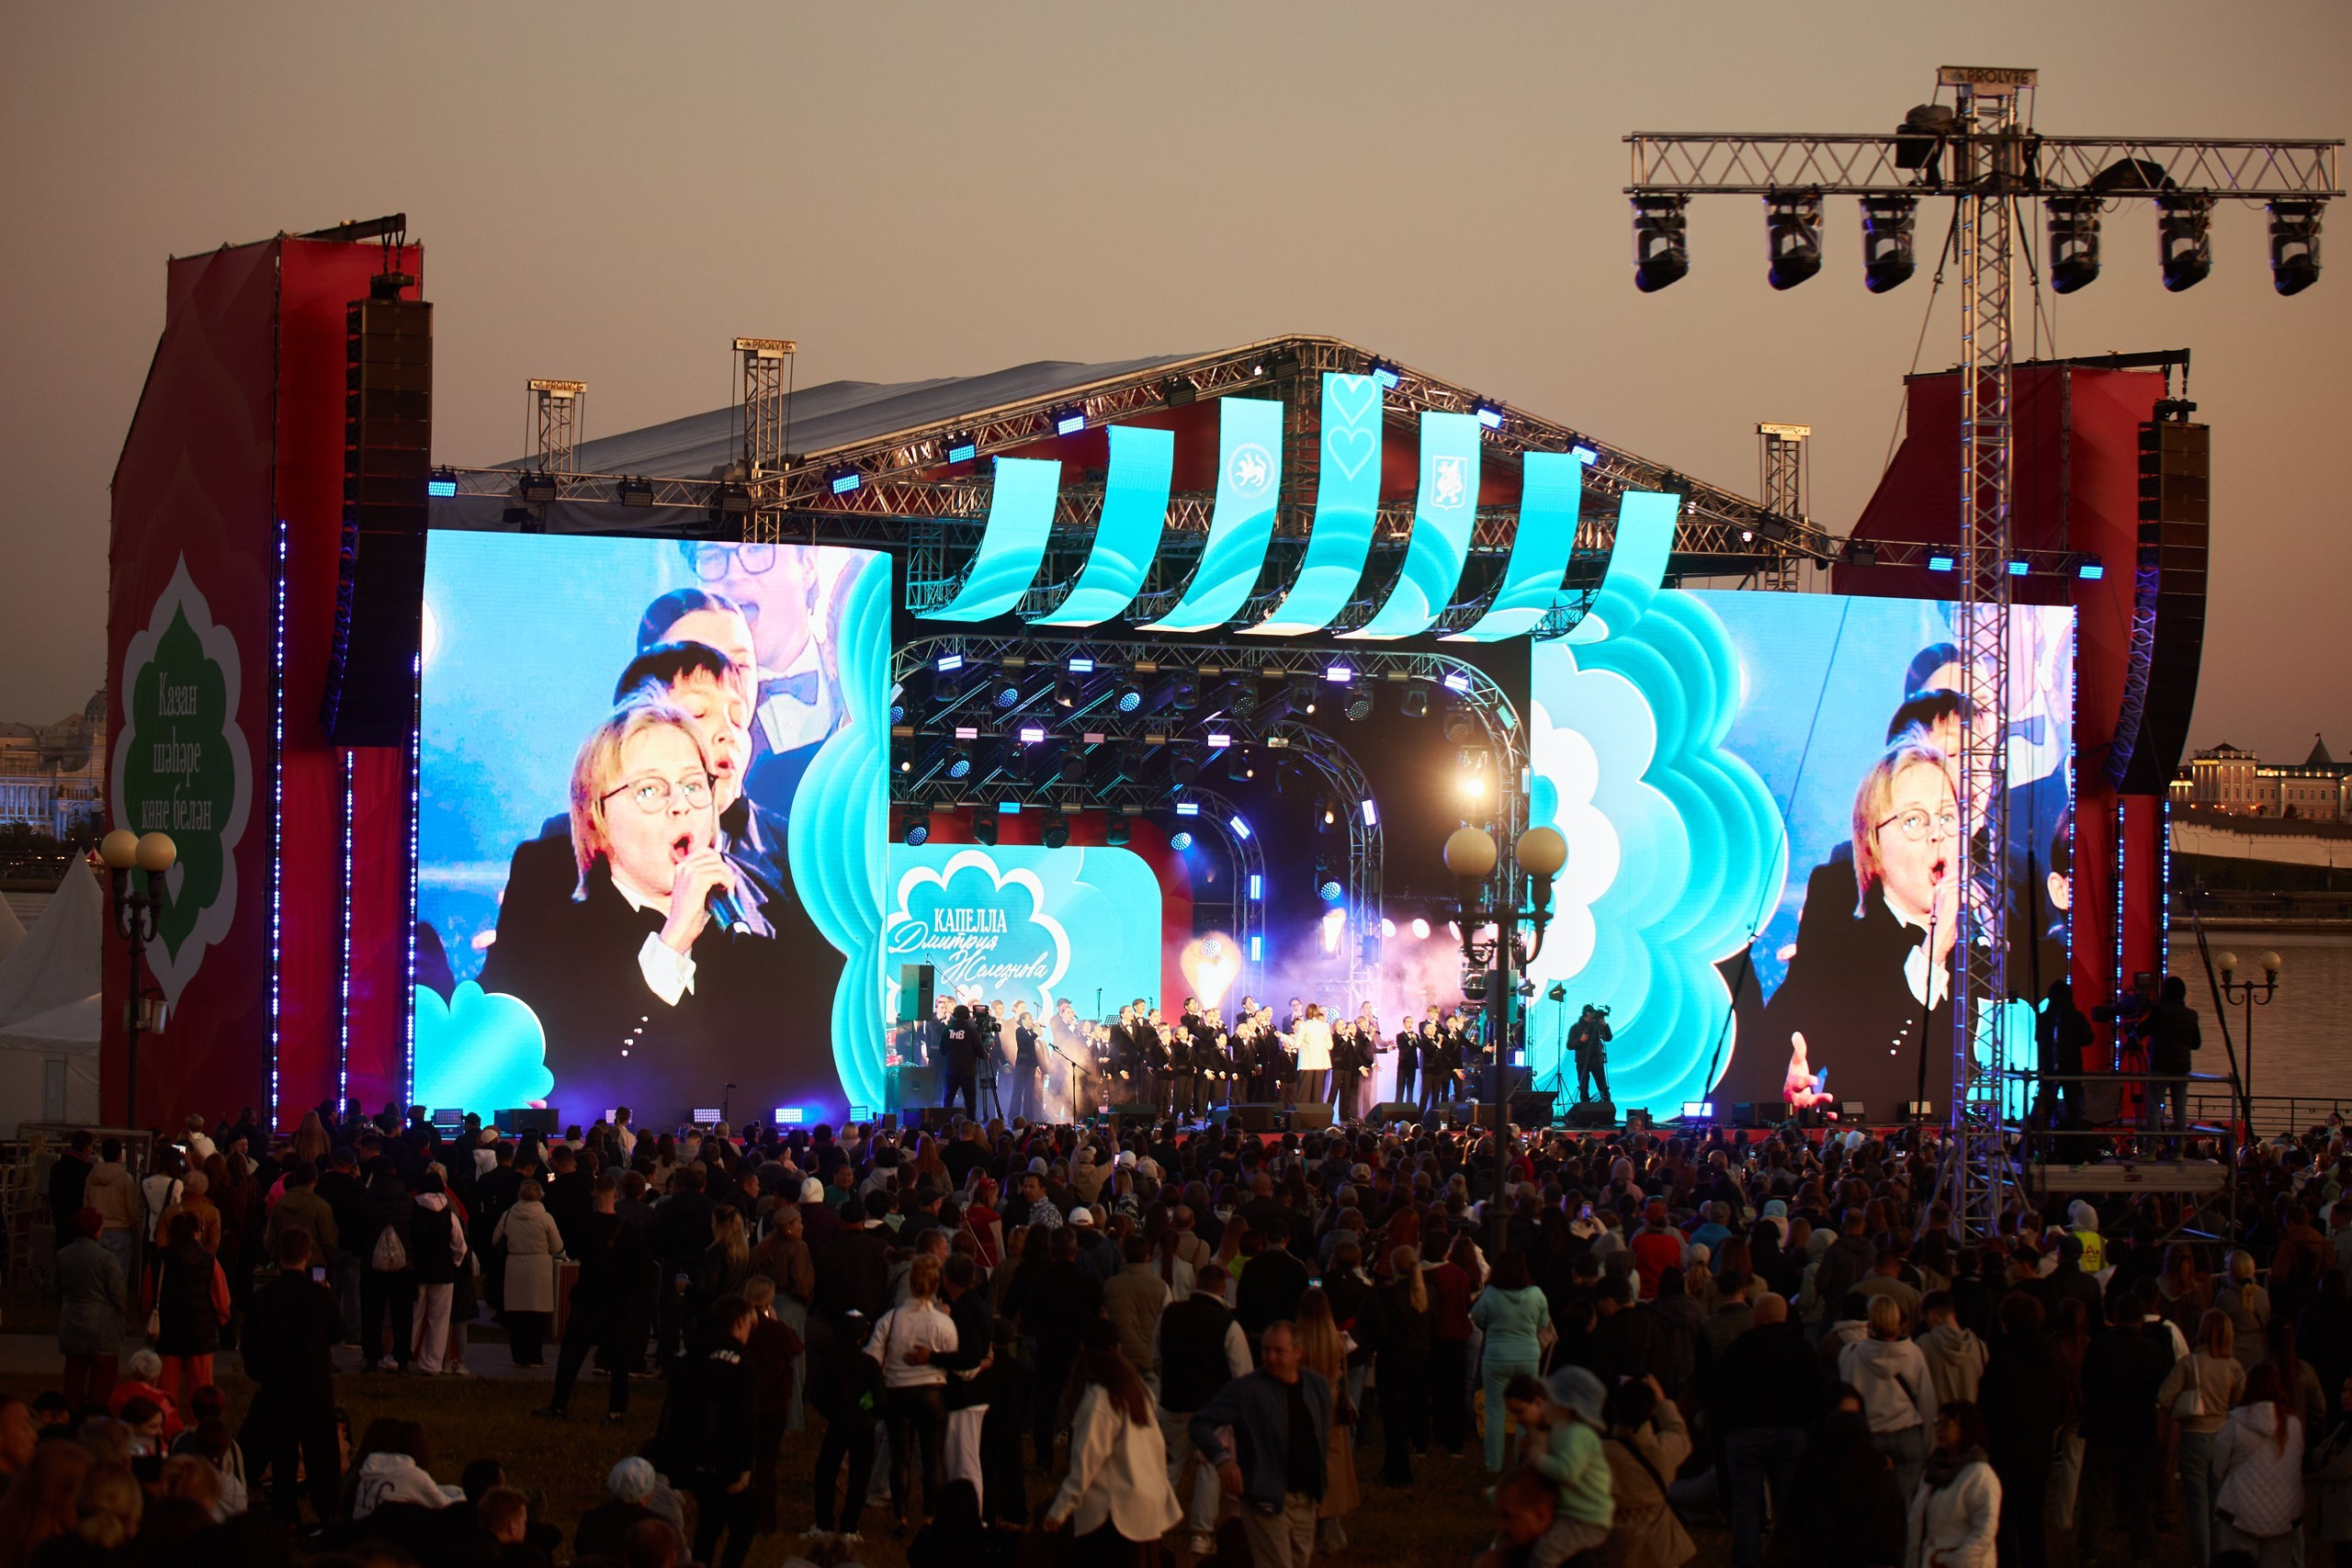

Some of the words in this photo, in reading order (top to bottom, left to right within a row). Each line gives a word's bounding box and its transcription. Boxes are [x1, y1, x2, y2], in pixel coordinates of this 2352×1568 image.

[1967, 70, 2030, 85] PROLYTE
[752, 340, 790, 351] PROLYTE
[546, 381, 582, 391] PROLYTE
[158, 671, 198, 716] Казан
[153, 726, 201, 787] шәһәре
[141, 799, 170, 830] көне
[173, 783, 212, 831] белән
[933, 908, 1007, 933] КАПЕЛЛА
[888, 921, 999, 953] Дмитрия
[941, 950, 1048, 989] Железнова
